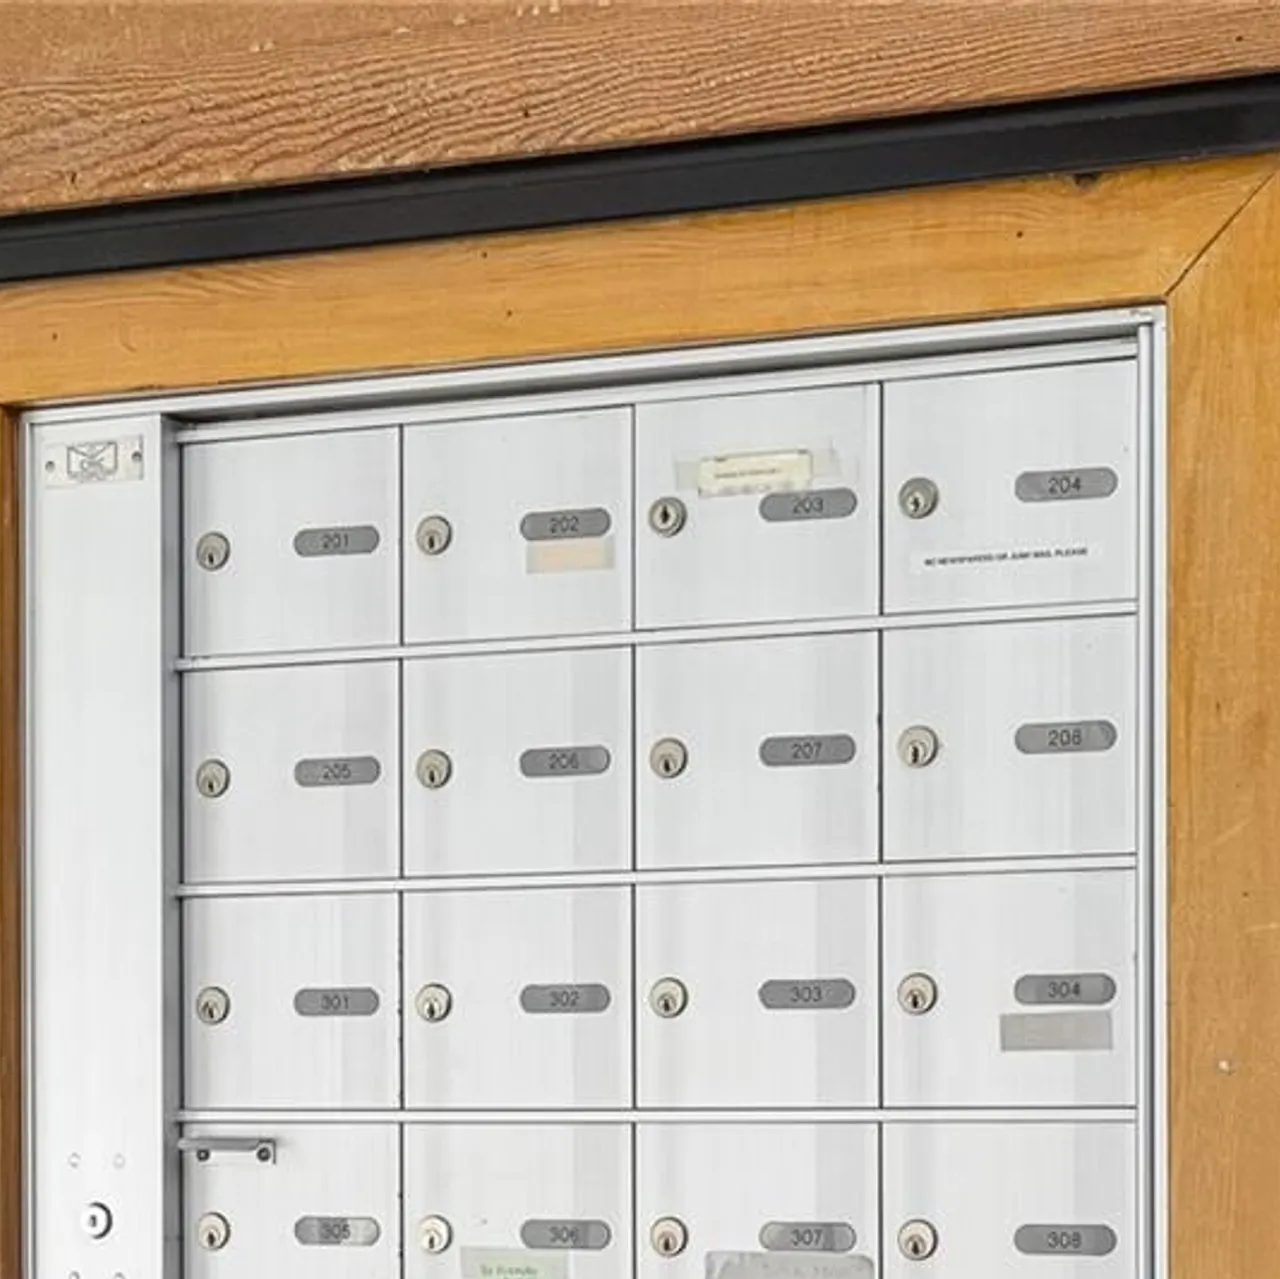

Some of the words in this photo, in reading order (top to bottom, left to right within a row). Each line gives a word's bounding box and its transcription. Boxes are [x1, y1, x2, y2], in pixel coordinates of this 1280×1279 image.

[1048, 476, 1081, 494] 204
[793, 496, 823, 514] 203
[550, 516, 579, 534] 202
[322, 533, 349, 551] 201
[1055, 546, 1088, 558] PLEASE
[1048, 729, 1081, 747] 208
[793, 742, 821, 760] 207
[549, 752, 578, 770] 206
[323, 763, 351, 780] 205
[549, 990, 579, 1007] 302
[790, 986, 821, 1003] 303
[1048, 982, 1080, 999] 304
[320, 994, 349, 1010] 301
[790, 1229, 823, 1246] 307
[1047, 1232, 1081, 1249] 308
